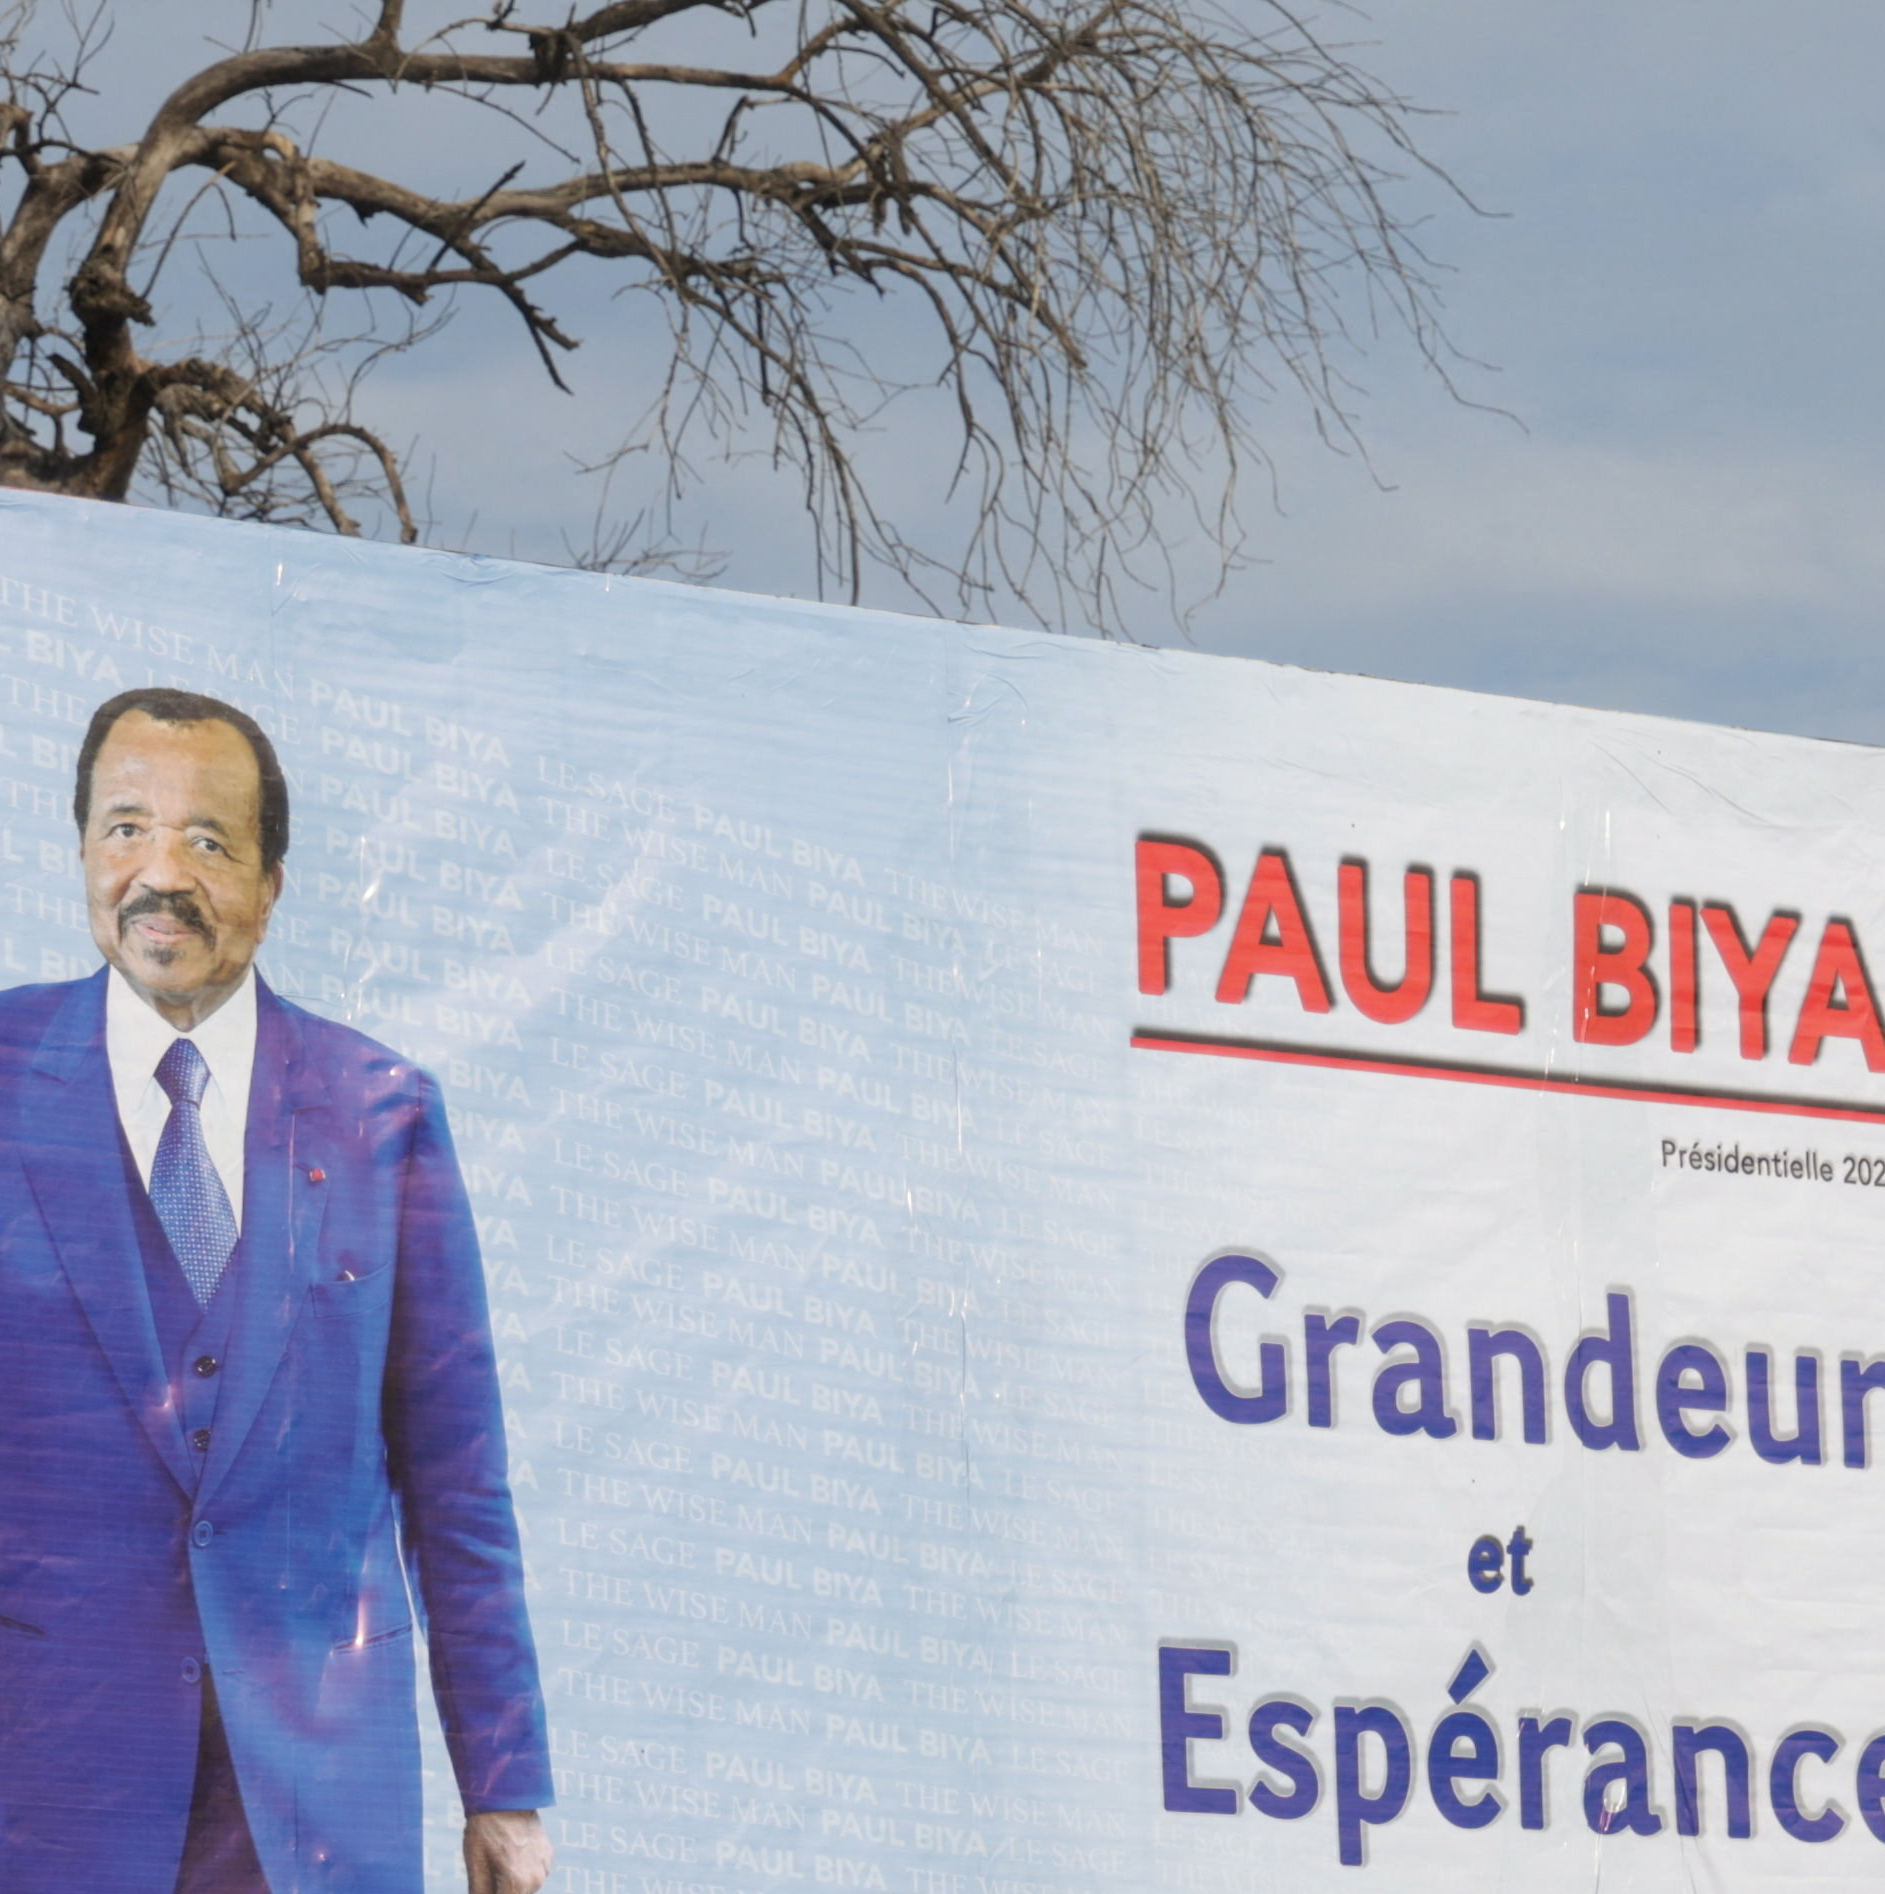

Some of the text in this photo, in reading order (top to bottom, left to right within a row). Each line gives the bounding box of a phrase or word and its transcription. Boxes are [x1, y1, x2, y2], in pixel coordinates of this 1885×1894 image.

[27, 631, 124, 689] BIYA
[91, 605, 194, 665] WISE
[207, 644, 295, 700] MAN
[311, 679, 413, 736] PAUL
[424, 716, 511, 768] BIYA
[538, 755, 576, 789] LE
[588, 772, 675, 822] SAGE
[694, 804, 781, 858] PAUL
[792, 839, 865, 887] BIYA
[884, 868, 947, 912] THE
[950, 889, 1022, 933] WISE
[322, 726, 421, 781] PAUL
[435, 763, 521, 816] BIYA
[539, 796, 612, 841] THE
[623, 821, 709, 872] WISE
[719, 853, 793, 901] MAN
[808, 881, 892, 932] PAUL
[321, 774, 421, 830] PAUL
[435, 810, 516, 860] BIYA
[545, 846, 585, 881] LE
[596, 862, 685, 913] SAGE
[703, 894, 789, 946] PAUL
[799, 925, 871, 974] BIYA
[1135, 834, 1524, 1033] PAUL
[1661, 1140, 1834, 1183] Présidentielle
[547, 1275, 619, 1315] THE
[633, 1294, 718, 1338] WISE
[728, 1318, 804, 1358] MAN
[820, 1336, 903, 1381] PAUL
[916, 1362, 980, 1399] BIYA
[597, 1248, 1041, 1374] SAGE PAUL BIYA THE WISE
[557, 1325, 1048, 1457] LE SAGE PAUL BIYA THE WISE
[1468, 1526, 1532, 1596] et
